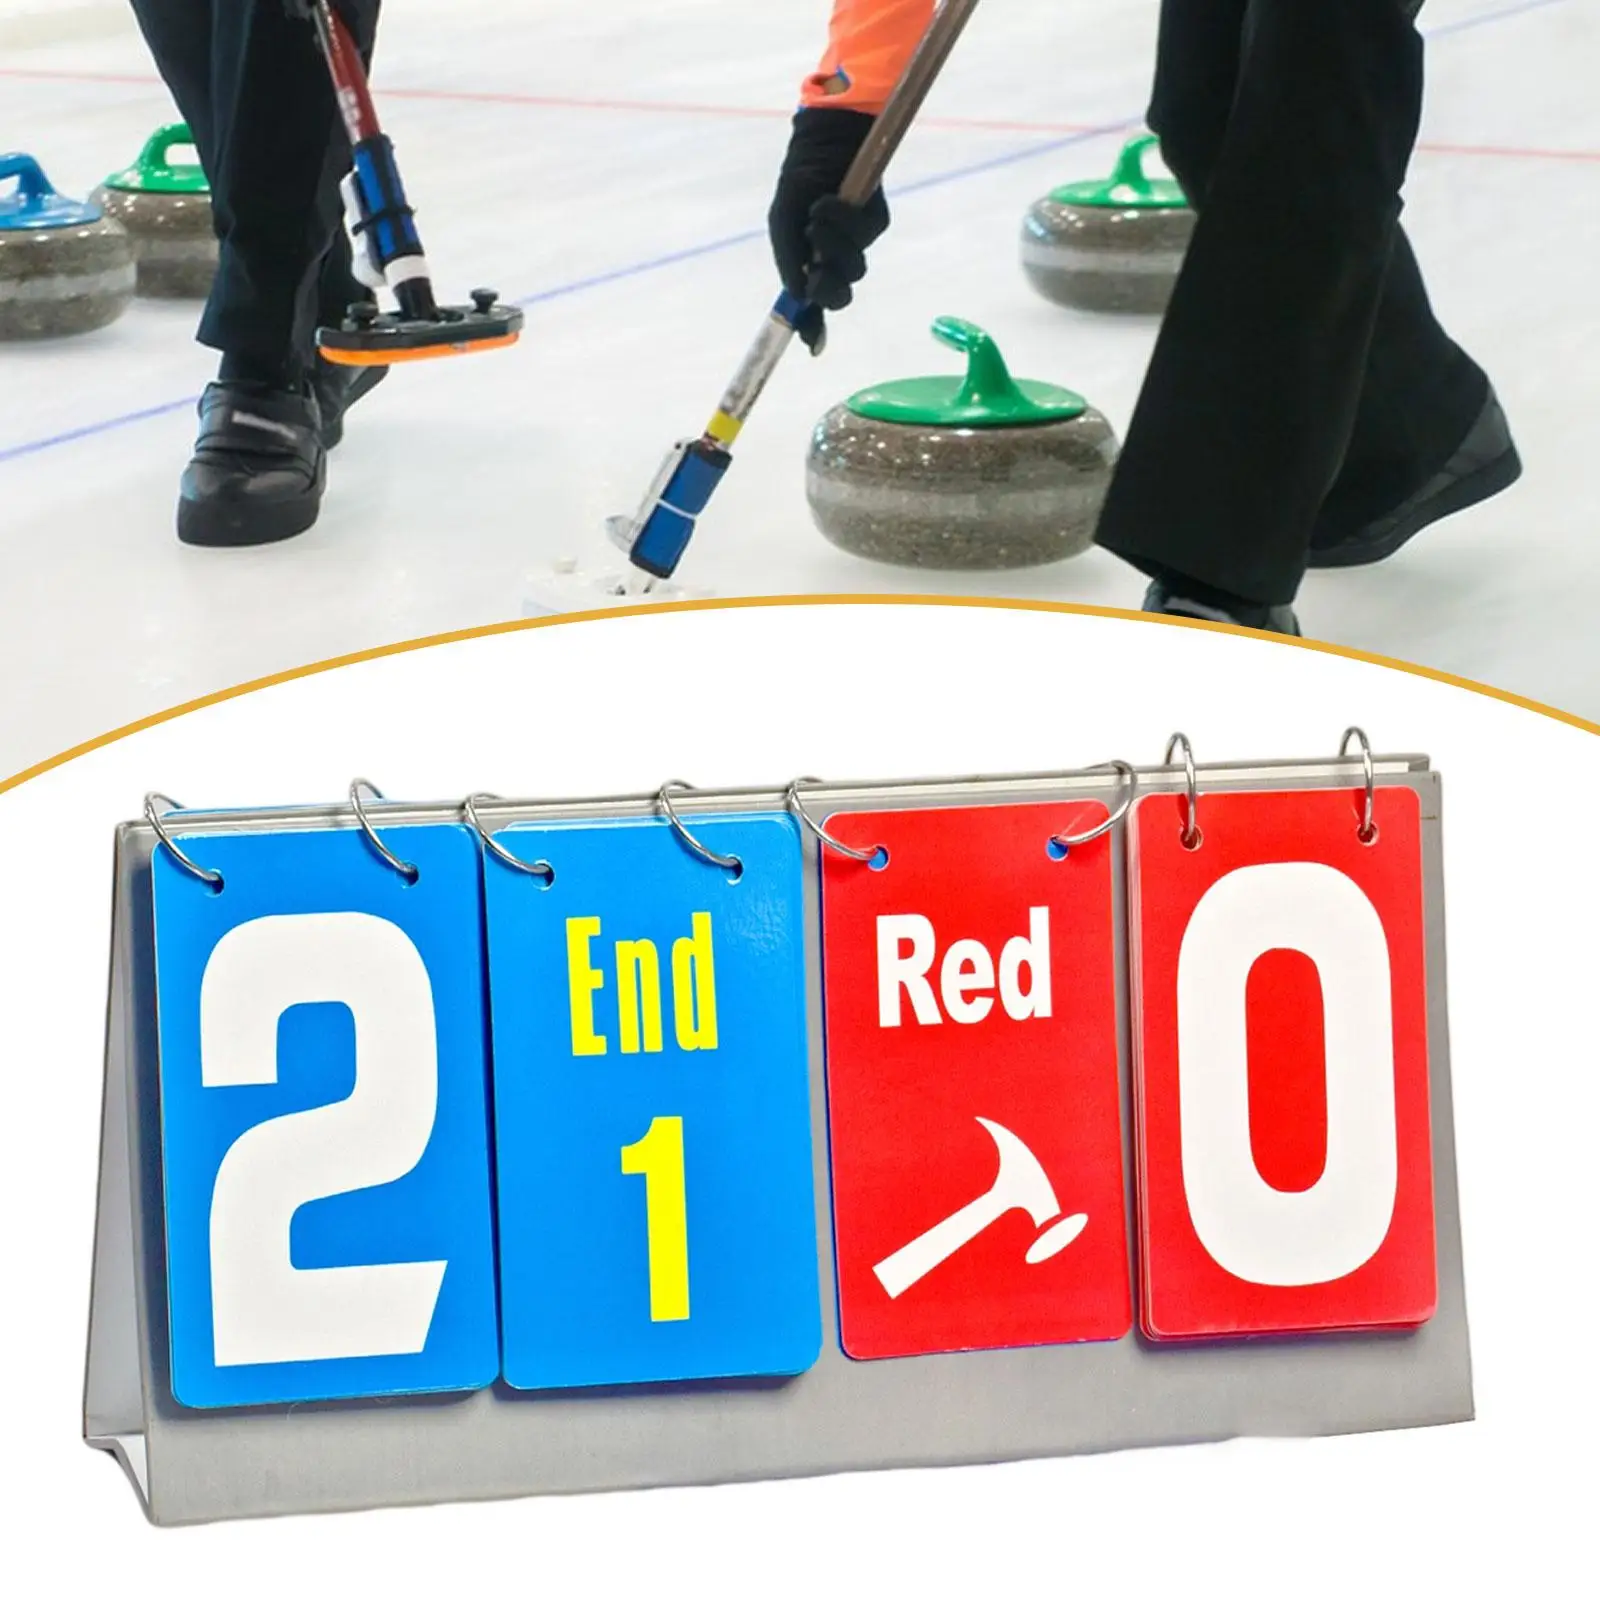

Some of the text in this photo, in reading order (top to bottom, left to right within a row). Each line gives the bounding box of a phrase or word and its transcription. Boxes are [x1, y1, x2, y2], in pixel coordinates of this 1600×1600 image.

[566, 912, 718, 1056] End
[876, 905, 1052, 1027] Red
[201, 912, 447, 1367] 2
[1177, 862, 1398, 1286] 0
[621, 1116, 689, 1322] 1
